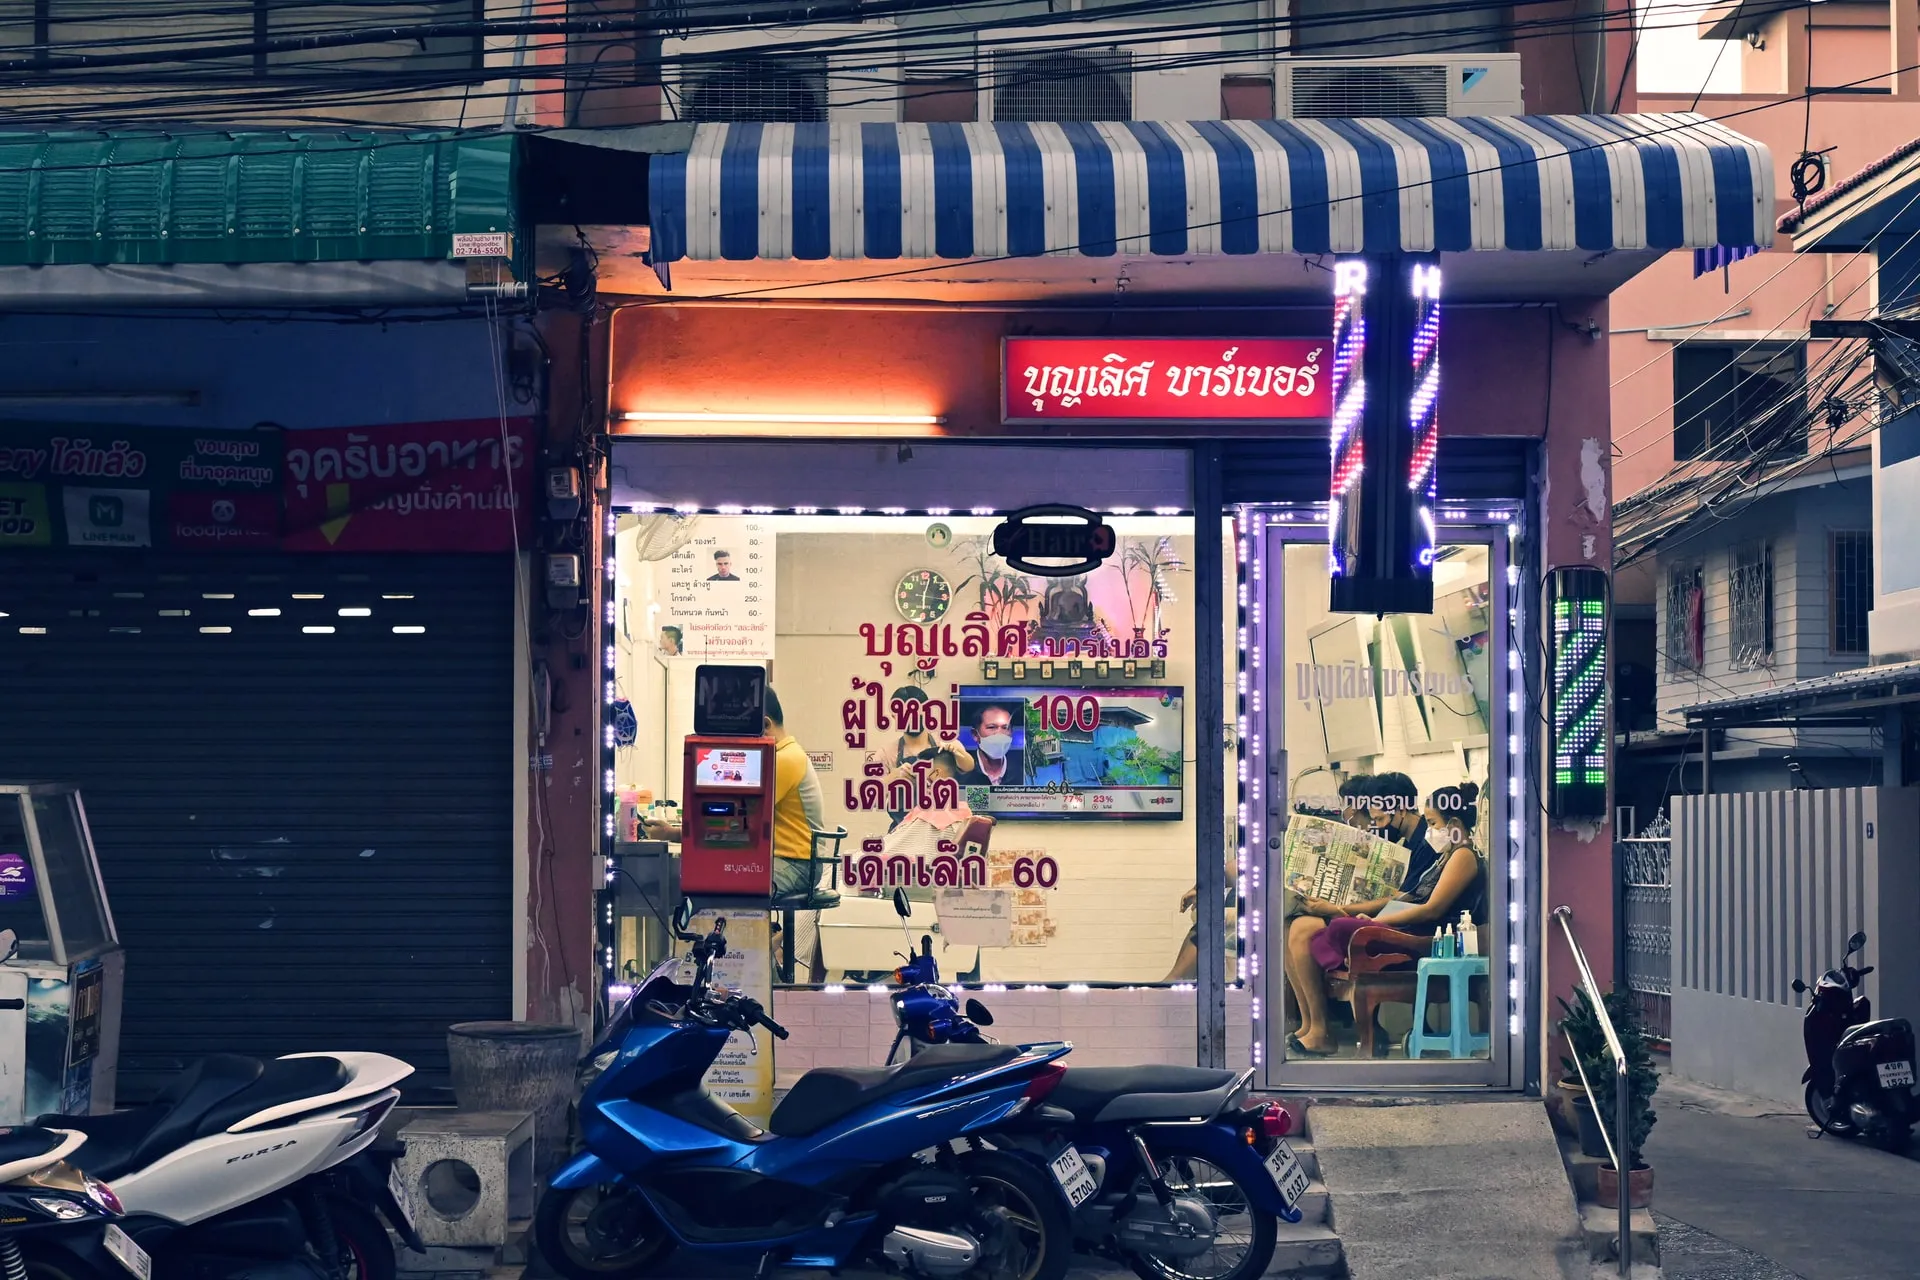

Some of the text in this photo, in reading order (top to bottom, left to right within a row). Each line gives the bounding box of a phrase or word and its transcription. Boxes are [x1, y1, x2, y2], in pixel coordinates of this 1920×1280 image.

[455, 247, 503, 255] 02-746-5500
[1023, 347, 1323, 411] บุญเลิศ บาร์เบอร์
[50, 436, 147, 478] ได้แล้ว
[194, 438, 260, 462] ขอบคุณ
[179, 455, 274, 487] ที่มาอุดหนุน
[286, 432, 525, 499] จุดรับอาหาร
[1028, 527, 1086, 554] Hair
[860, 611, 1172, 677] บุญเลิศ บาร์เบอร์
[842, 677, 1101, 749] ผู้ใหญ่ 100
[806, 752, 831, 762] ้ามเข้า
[844, 761, 959, 811] เด็กโต
[1063, 795, 1083, 803] 77%
[1093, 795, 1113, 803] 23%
[841, 839, 987, 888] เด็กเล็ก
[1886, 1077, 1908, 1087] 1527
[226, 1140, 297, 1164] FORZA
[1070, 1180, 1093, 1204] 5700
[1286, 1174, 1305, 1201] 6137
